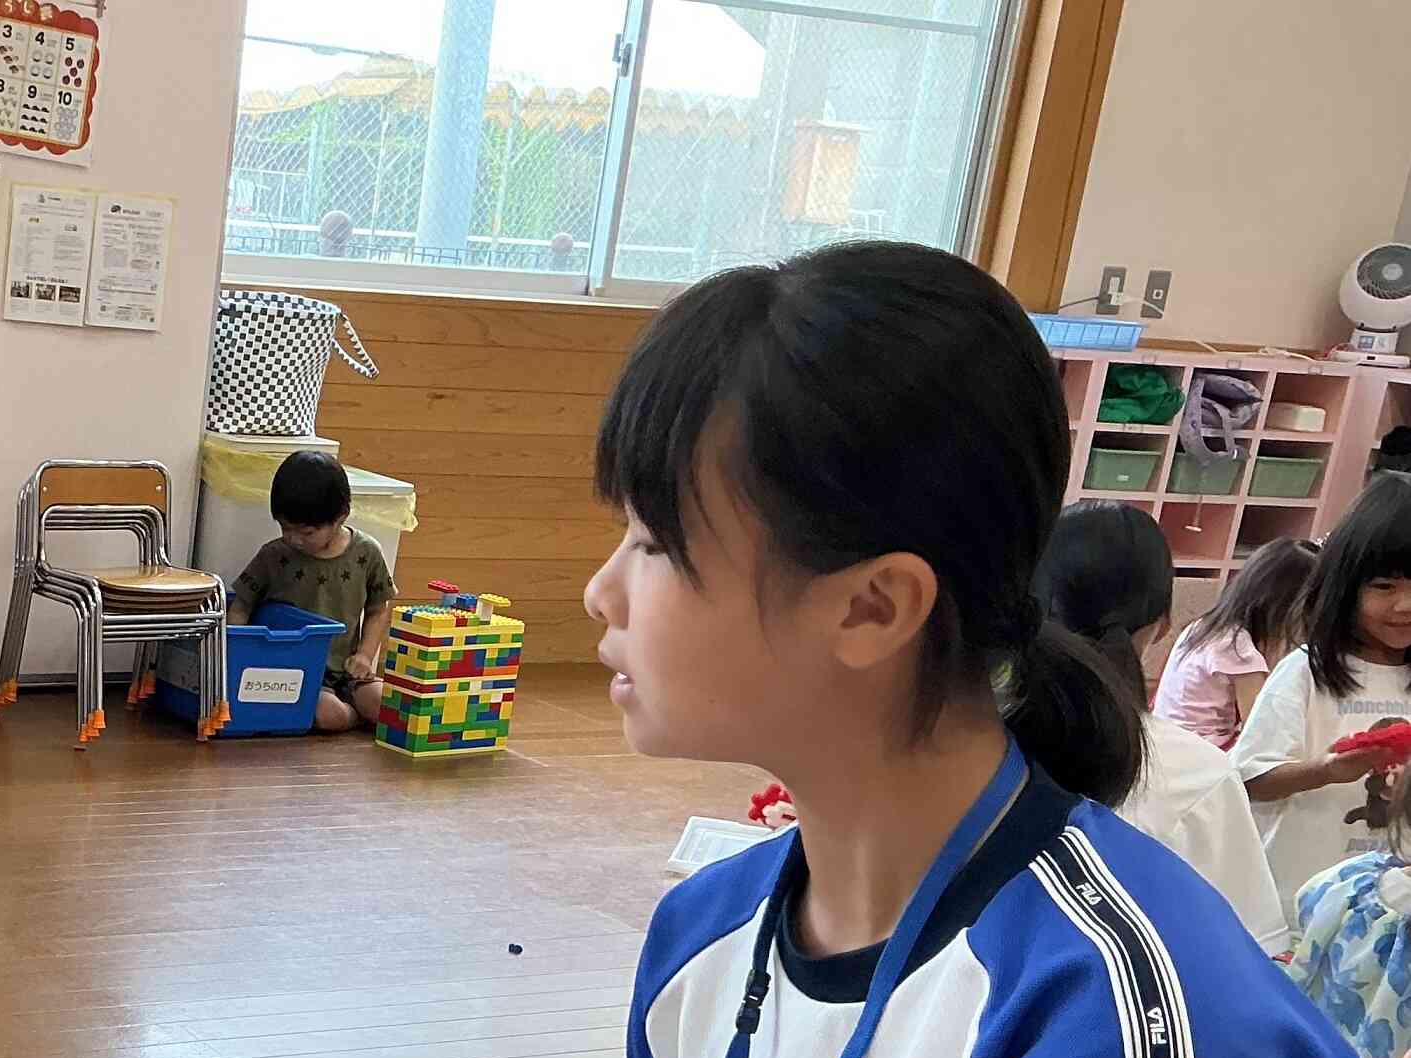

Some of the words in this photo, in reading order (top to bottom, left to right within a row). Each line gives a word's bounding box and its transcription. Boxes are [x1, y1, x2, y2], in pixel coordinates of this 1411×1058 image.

[2, 25, 12, 38] 3
[34, 32, 44, 45] 4
[65, 38, 75, 51] 5
[27, 85, 37, 99] 9
[57, 91, 72, 105] 10
[1075, 882, 1103, 906] FILA
[1147, 1006, 1168, 1045] FILA
